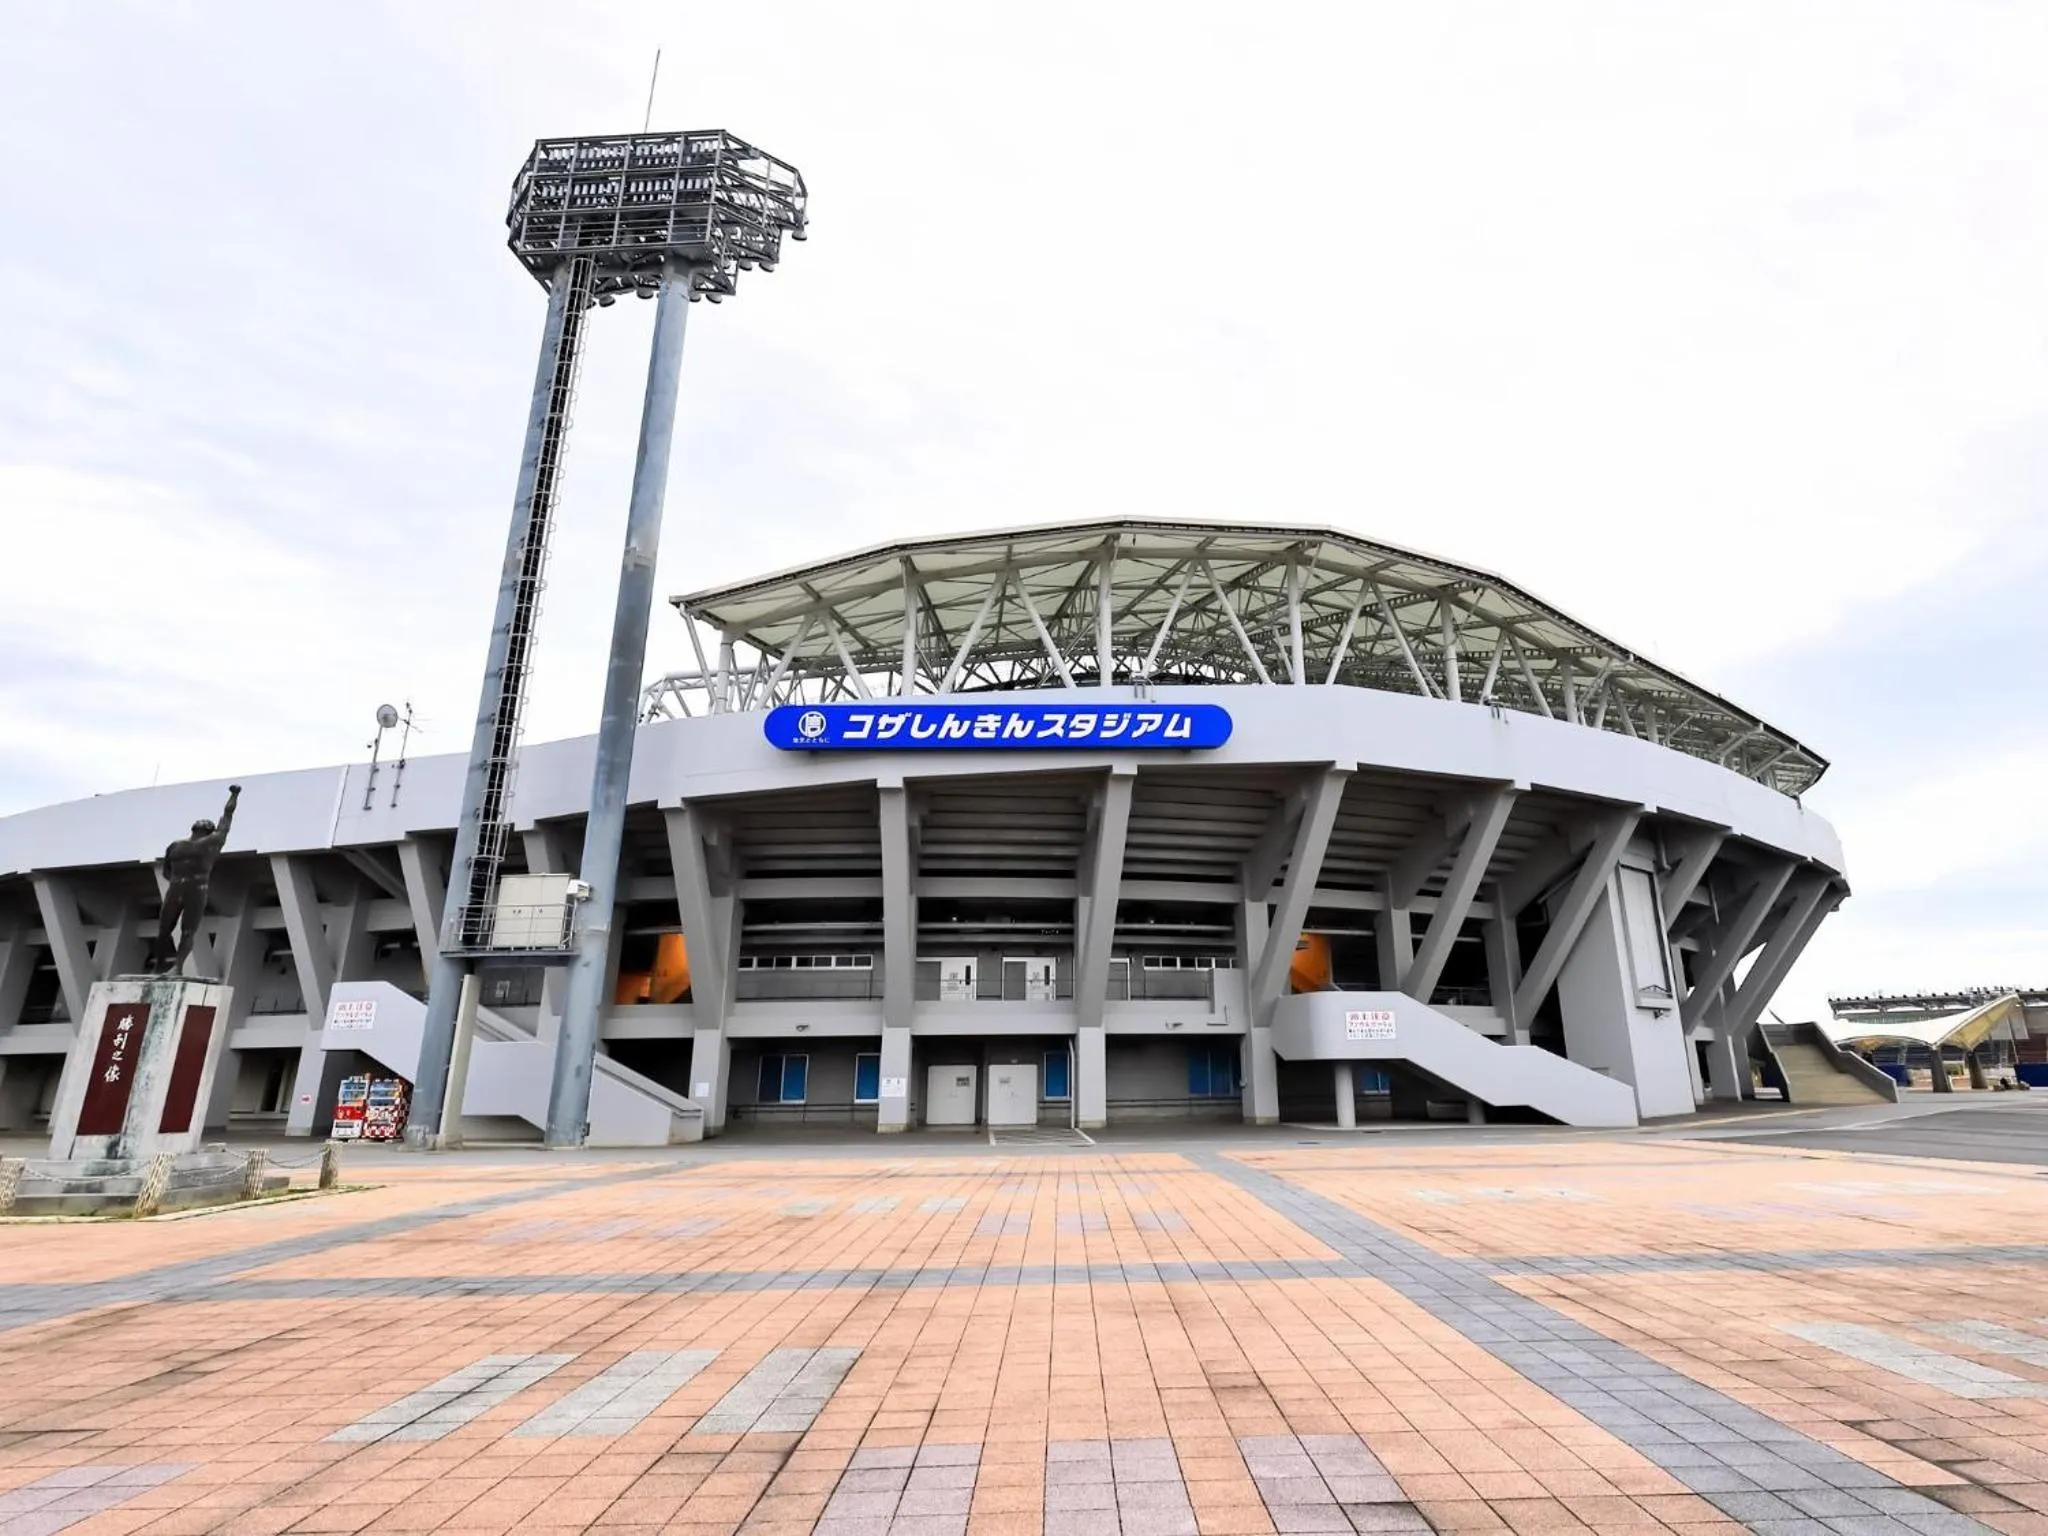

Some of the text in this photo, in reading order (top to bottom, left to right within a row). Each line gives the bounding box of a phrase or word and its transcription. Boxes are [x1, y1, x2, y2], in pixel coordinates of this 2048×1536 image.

[843, 712, 1192, 739] コザしんきんスタジアム
